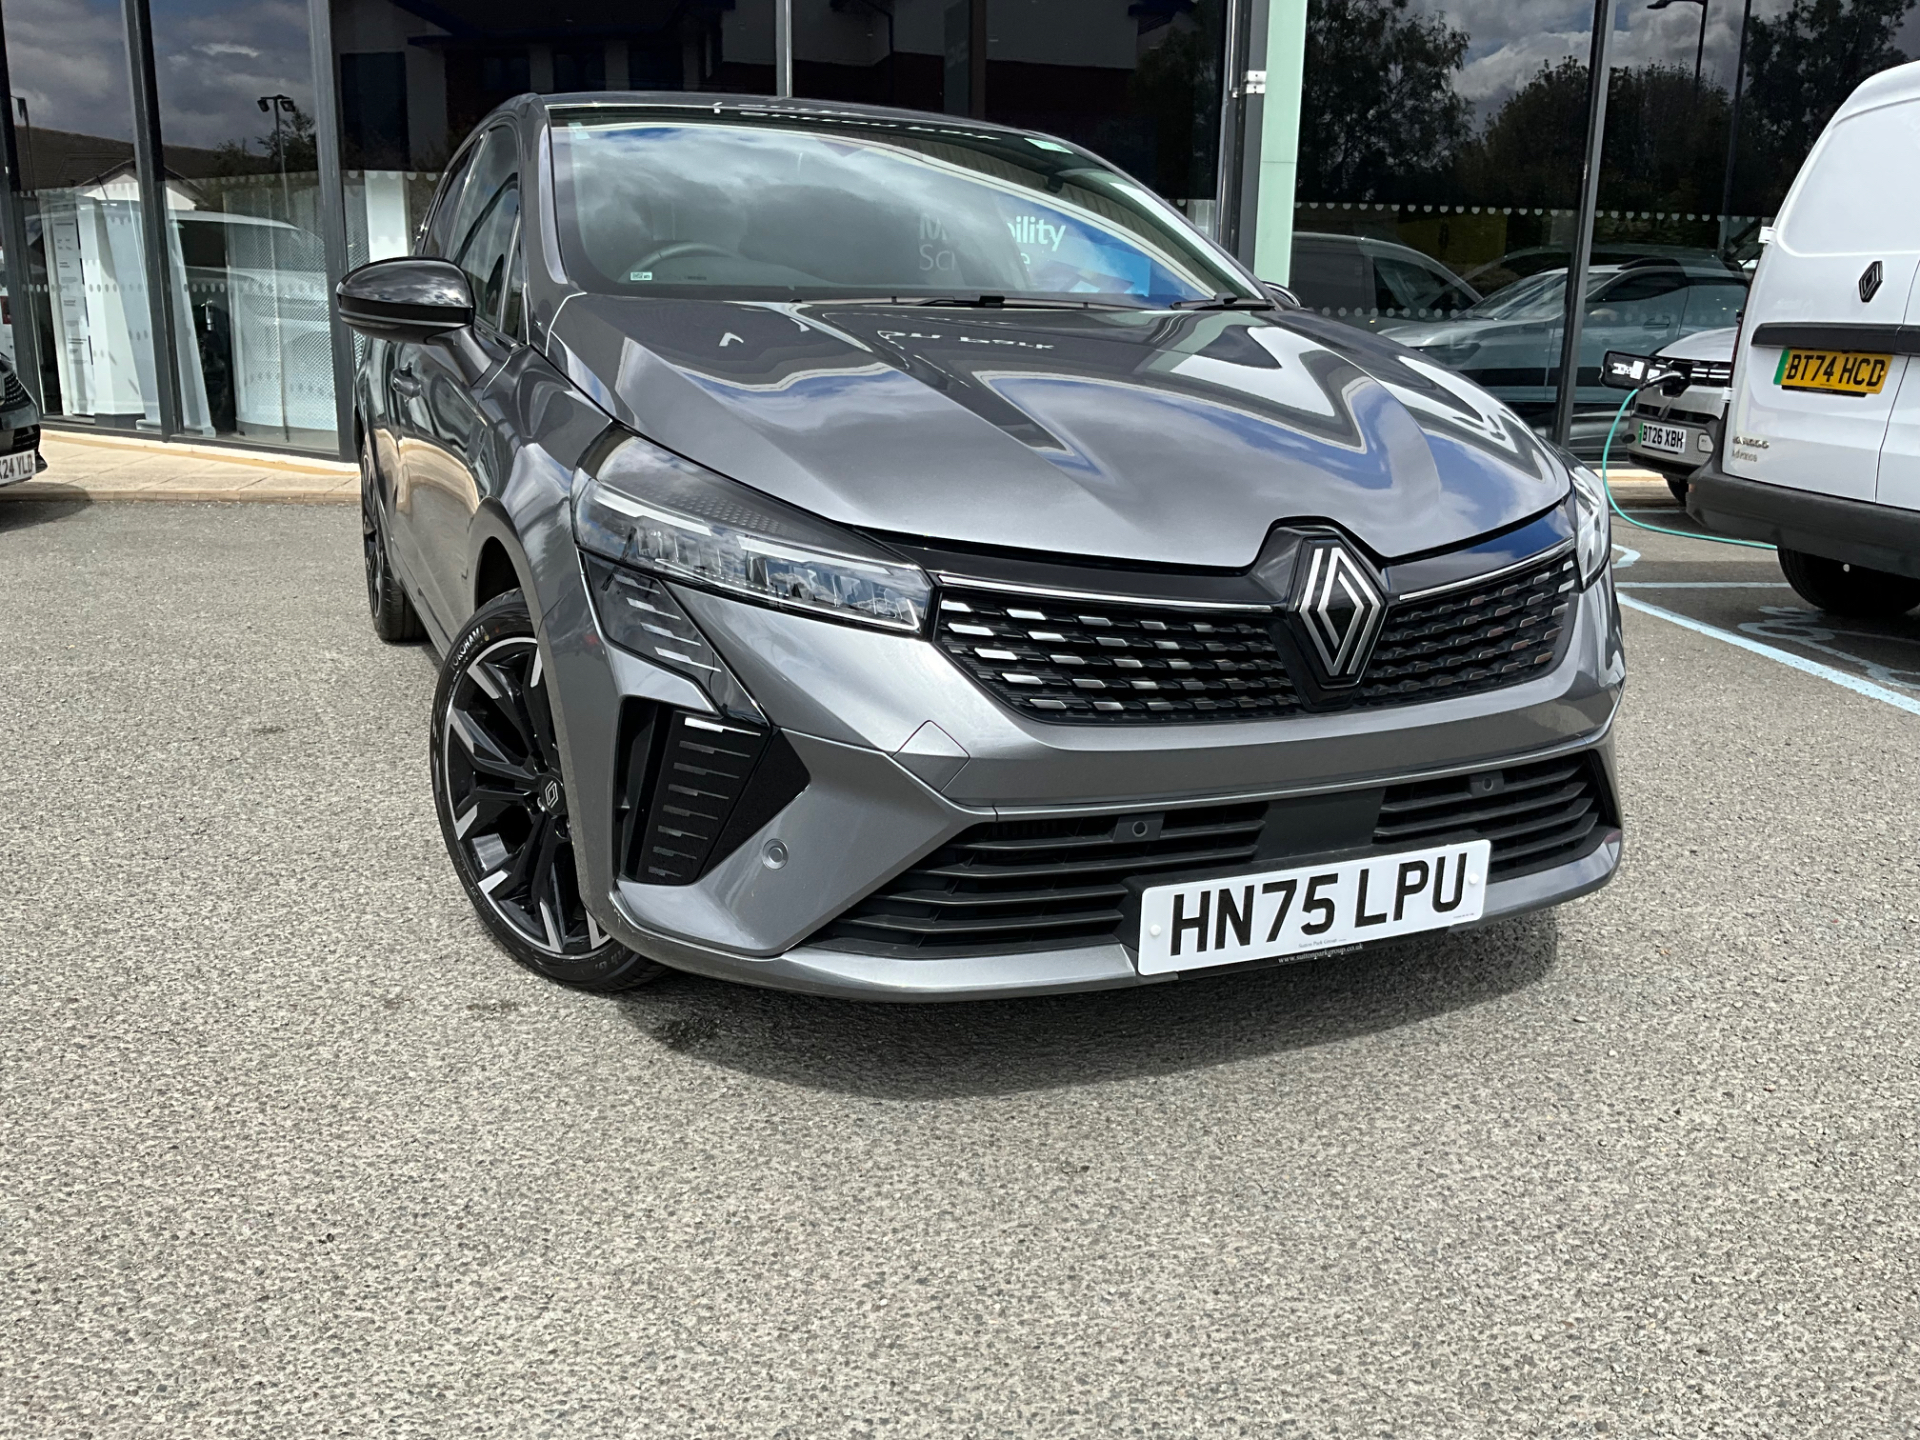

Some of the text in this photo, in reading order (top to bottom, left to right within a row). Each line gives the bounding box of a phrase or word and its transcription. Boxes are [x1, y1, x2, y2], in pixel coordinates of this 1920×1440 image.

[1786, 354, 1886, 387] BT74 HCD
[1643, 425, 1663, 445] BT26
[1170, 852, 1468, 956] HN75 LPU
